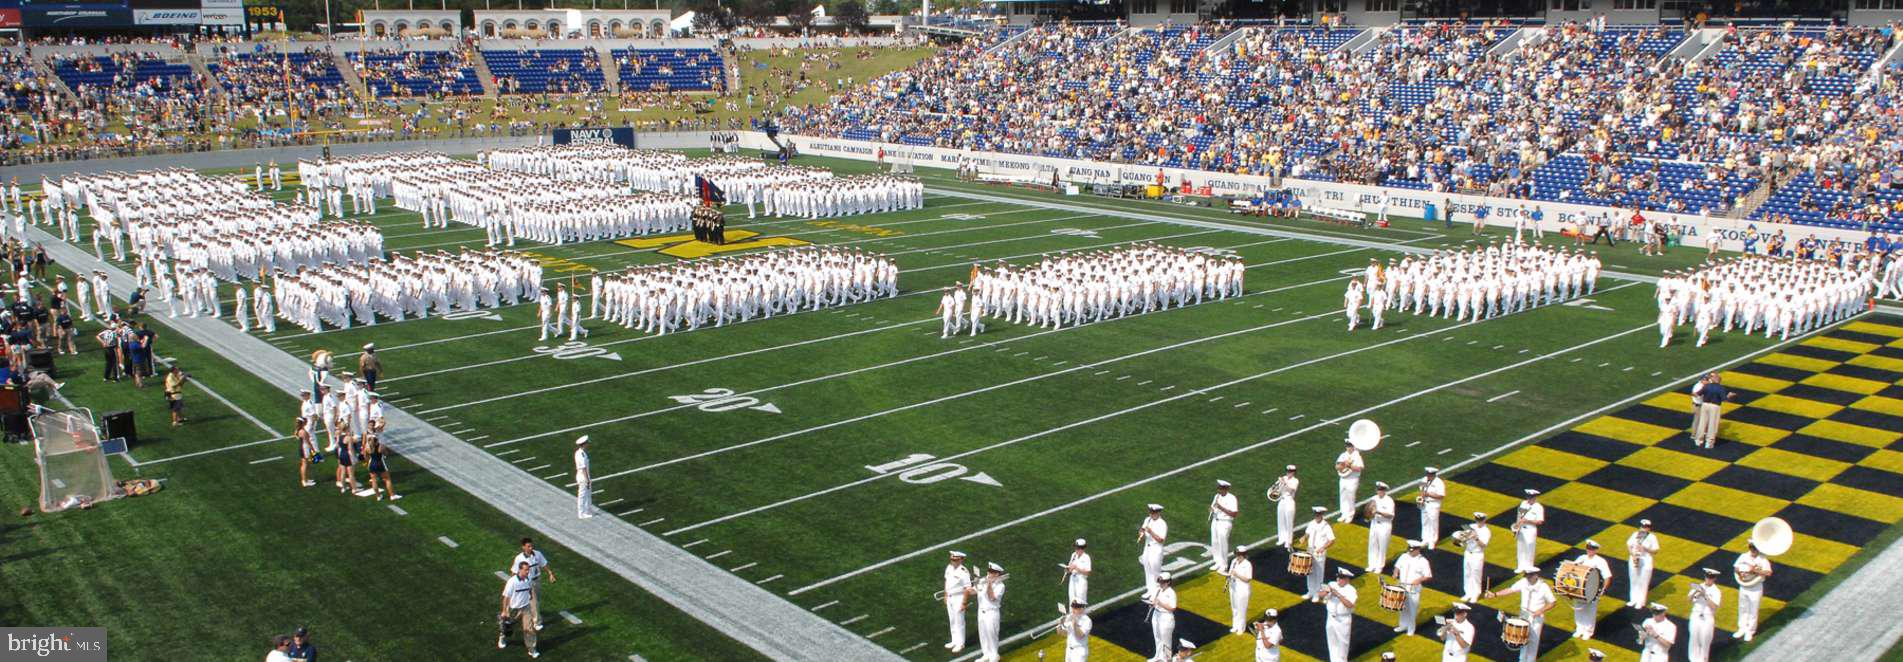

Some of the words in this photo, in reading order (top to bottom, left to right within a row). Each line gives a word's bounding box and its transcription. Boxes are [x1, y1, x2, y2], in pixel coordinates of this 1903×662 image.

[248, 6, 278, 16] 1953
[571, 130, 601, 139] NAVY
[999, 160, 1030, 170] MEKONG
[1122, 171, 1152, 181] QUANG
[1208, 180, 1241, 190] QUANG
[1324, 191, 1345, 201] TRI
[667, 387, 760, 412] 20
[864, 453, 969, 484] 10
